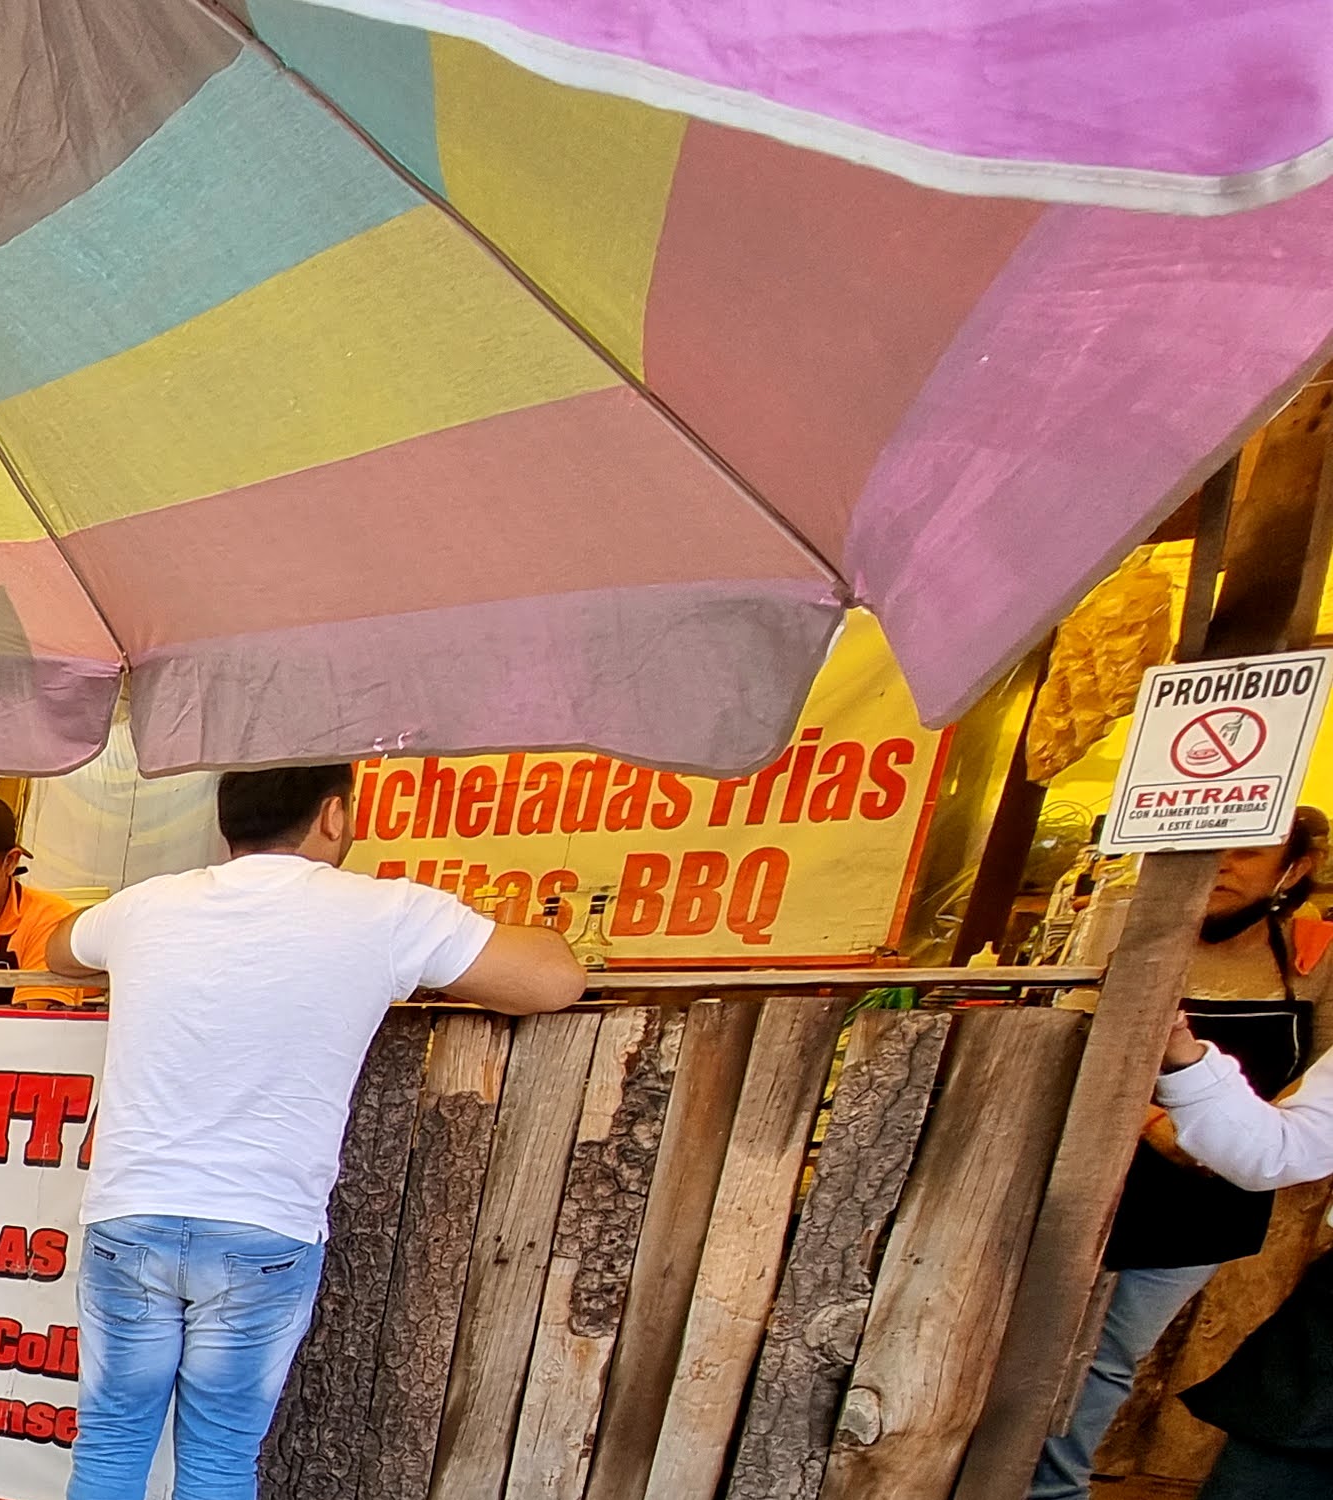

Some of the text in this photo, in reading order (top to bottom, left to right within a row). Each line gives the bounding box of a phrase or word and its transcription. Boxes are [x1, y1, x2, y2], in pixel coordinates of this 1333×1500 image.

[1154, 665, 1313, 708] PROHIBIDO
[352, 752, 694, 842] icheladas
[1129, 802, 1268, 819] CON ALIMENTOS Y BEBIDAS
[1134, 784, 1271, 808] ENTRAR
[1158, 822, 1165, 832] A
[1167, 820, 1192, 830] ESTE
[609, 846, 791, 946] BBQ
